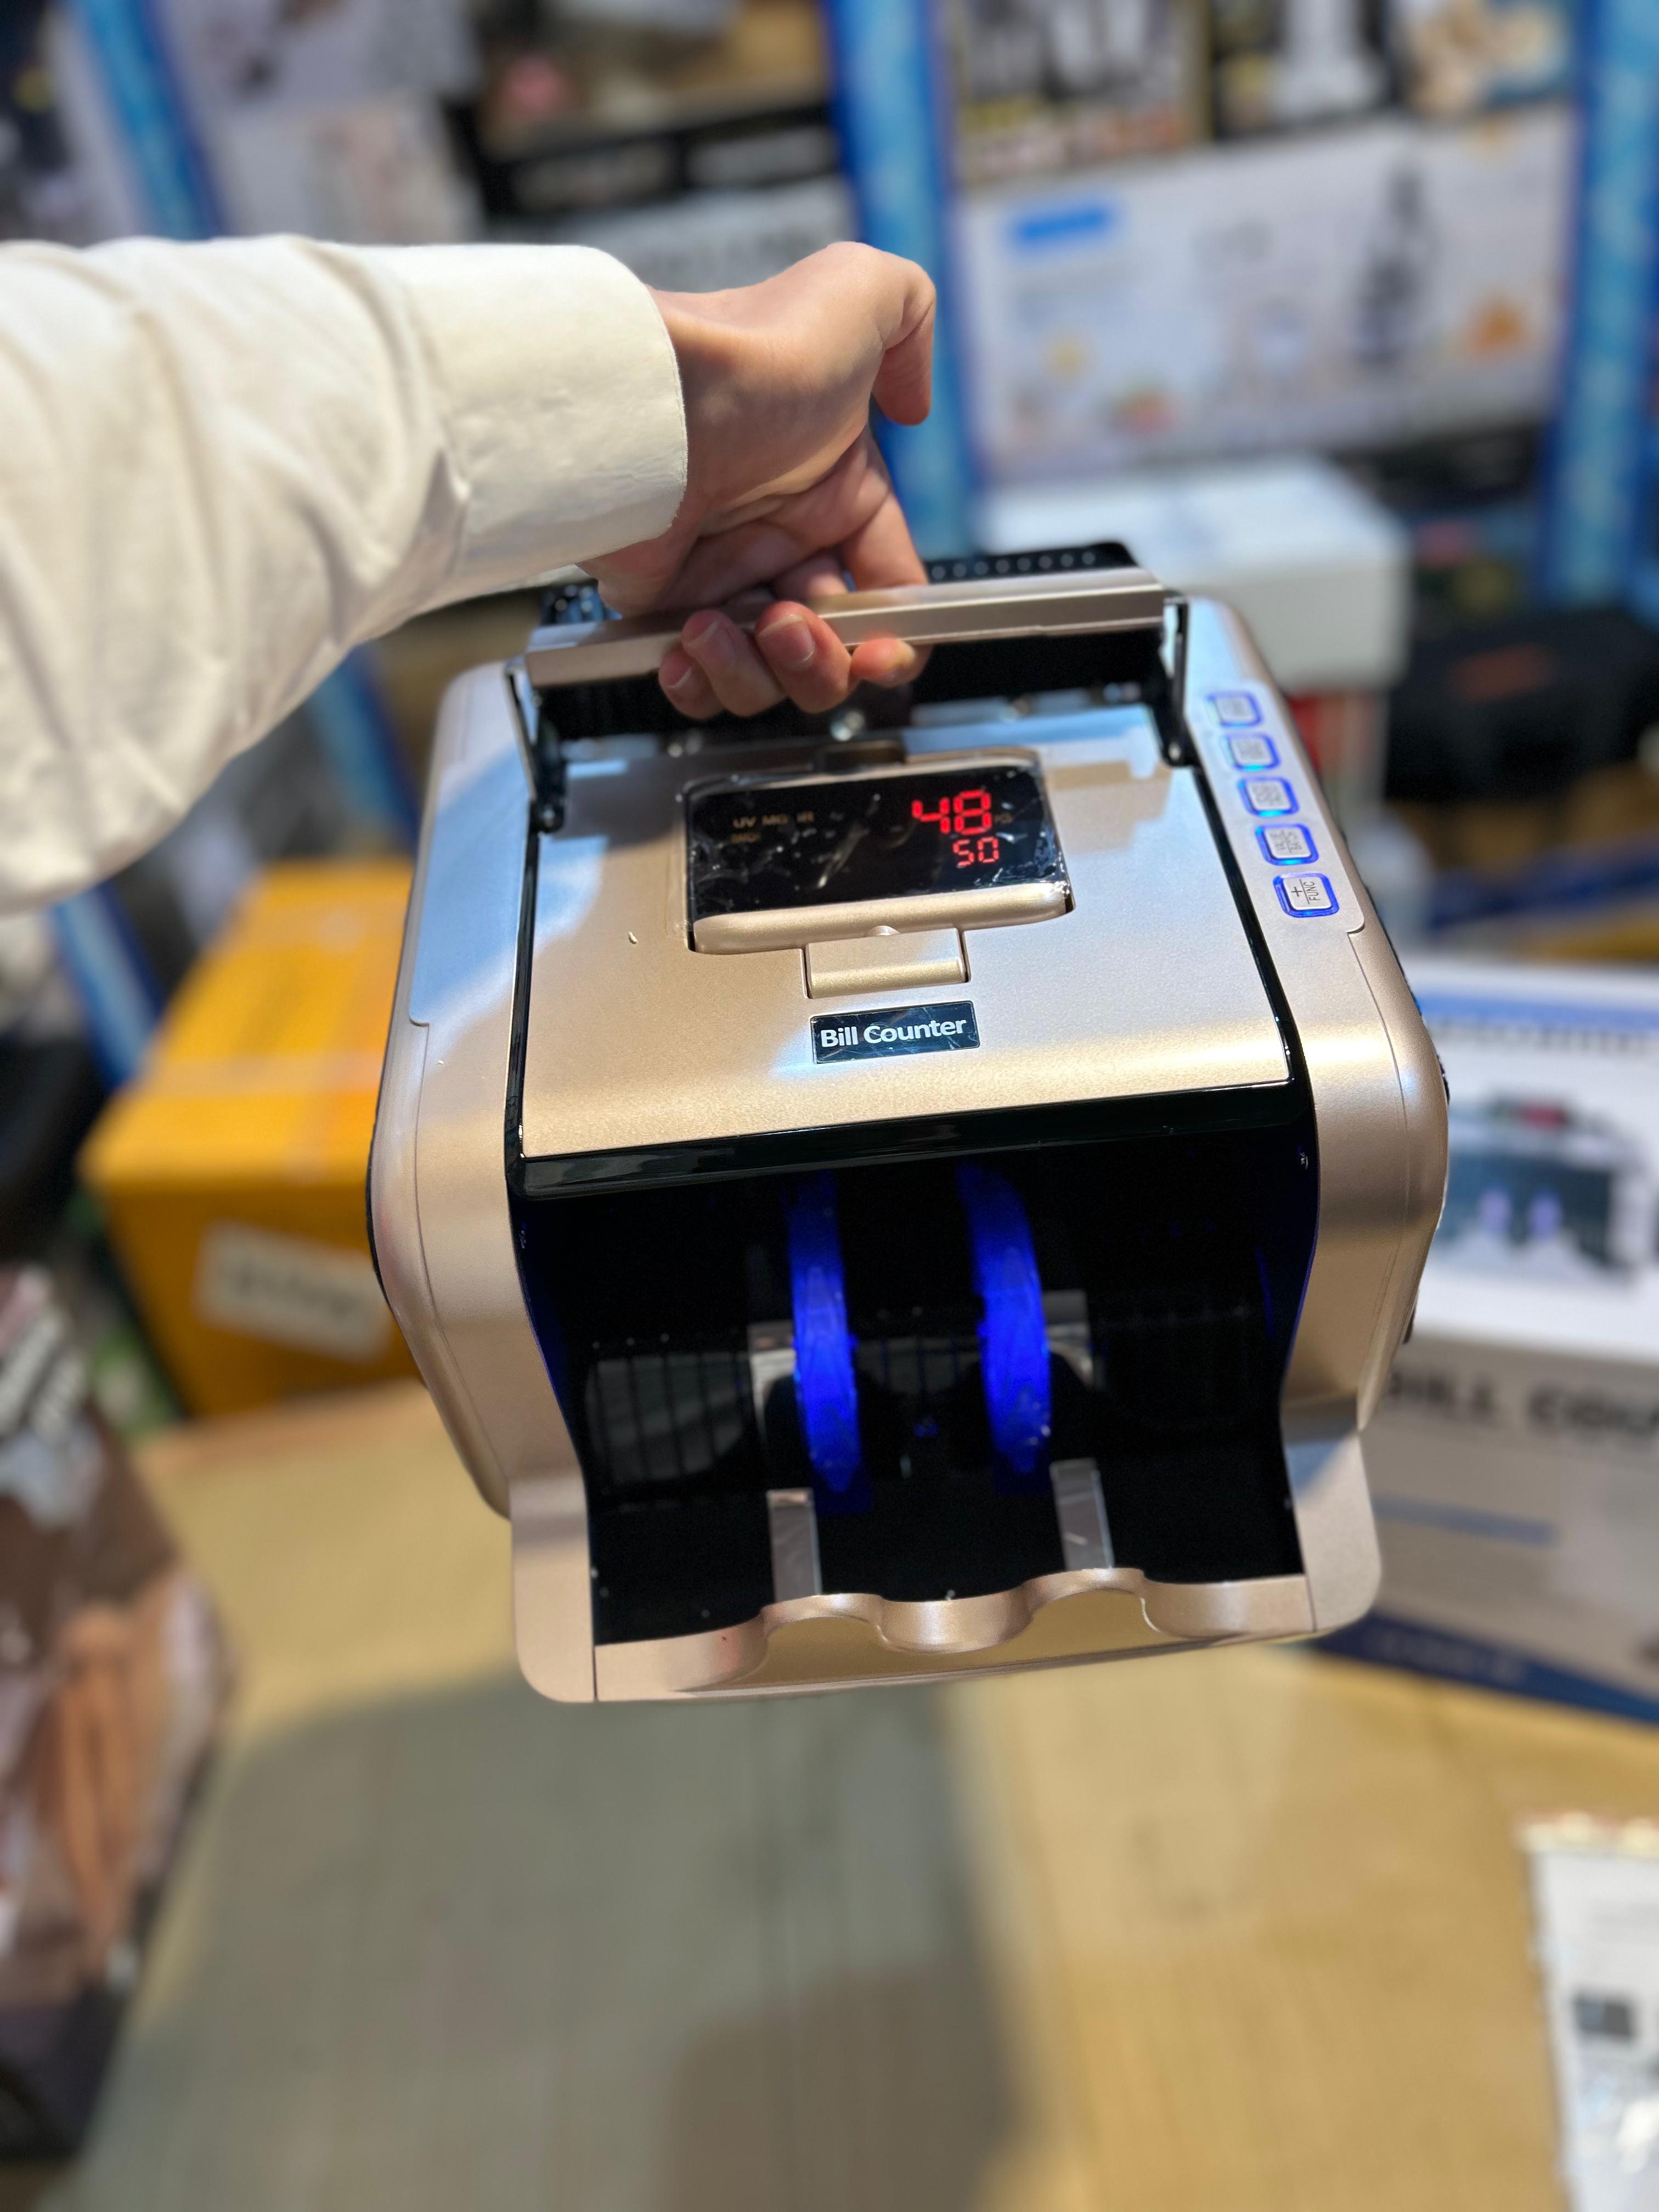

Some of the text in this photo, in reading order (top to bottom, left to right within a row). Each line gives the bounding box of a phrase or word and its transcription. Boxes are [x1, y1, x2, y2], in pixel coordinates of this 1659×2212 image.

[911, 789, 992, 835] 48
[952, 836, 1000, 867] 50
[1303, 881, 1322, 901] FUNC
[821, 1019, 967, 1047] Bill Counter
